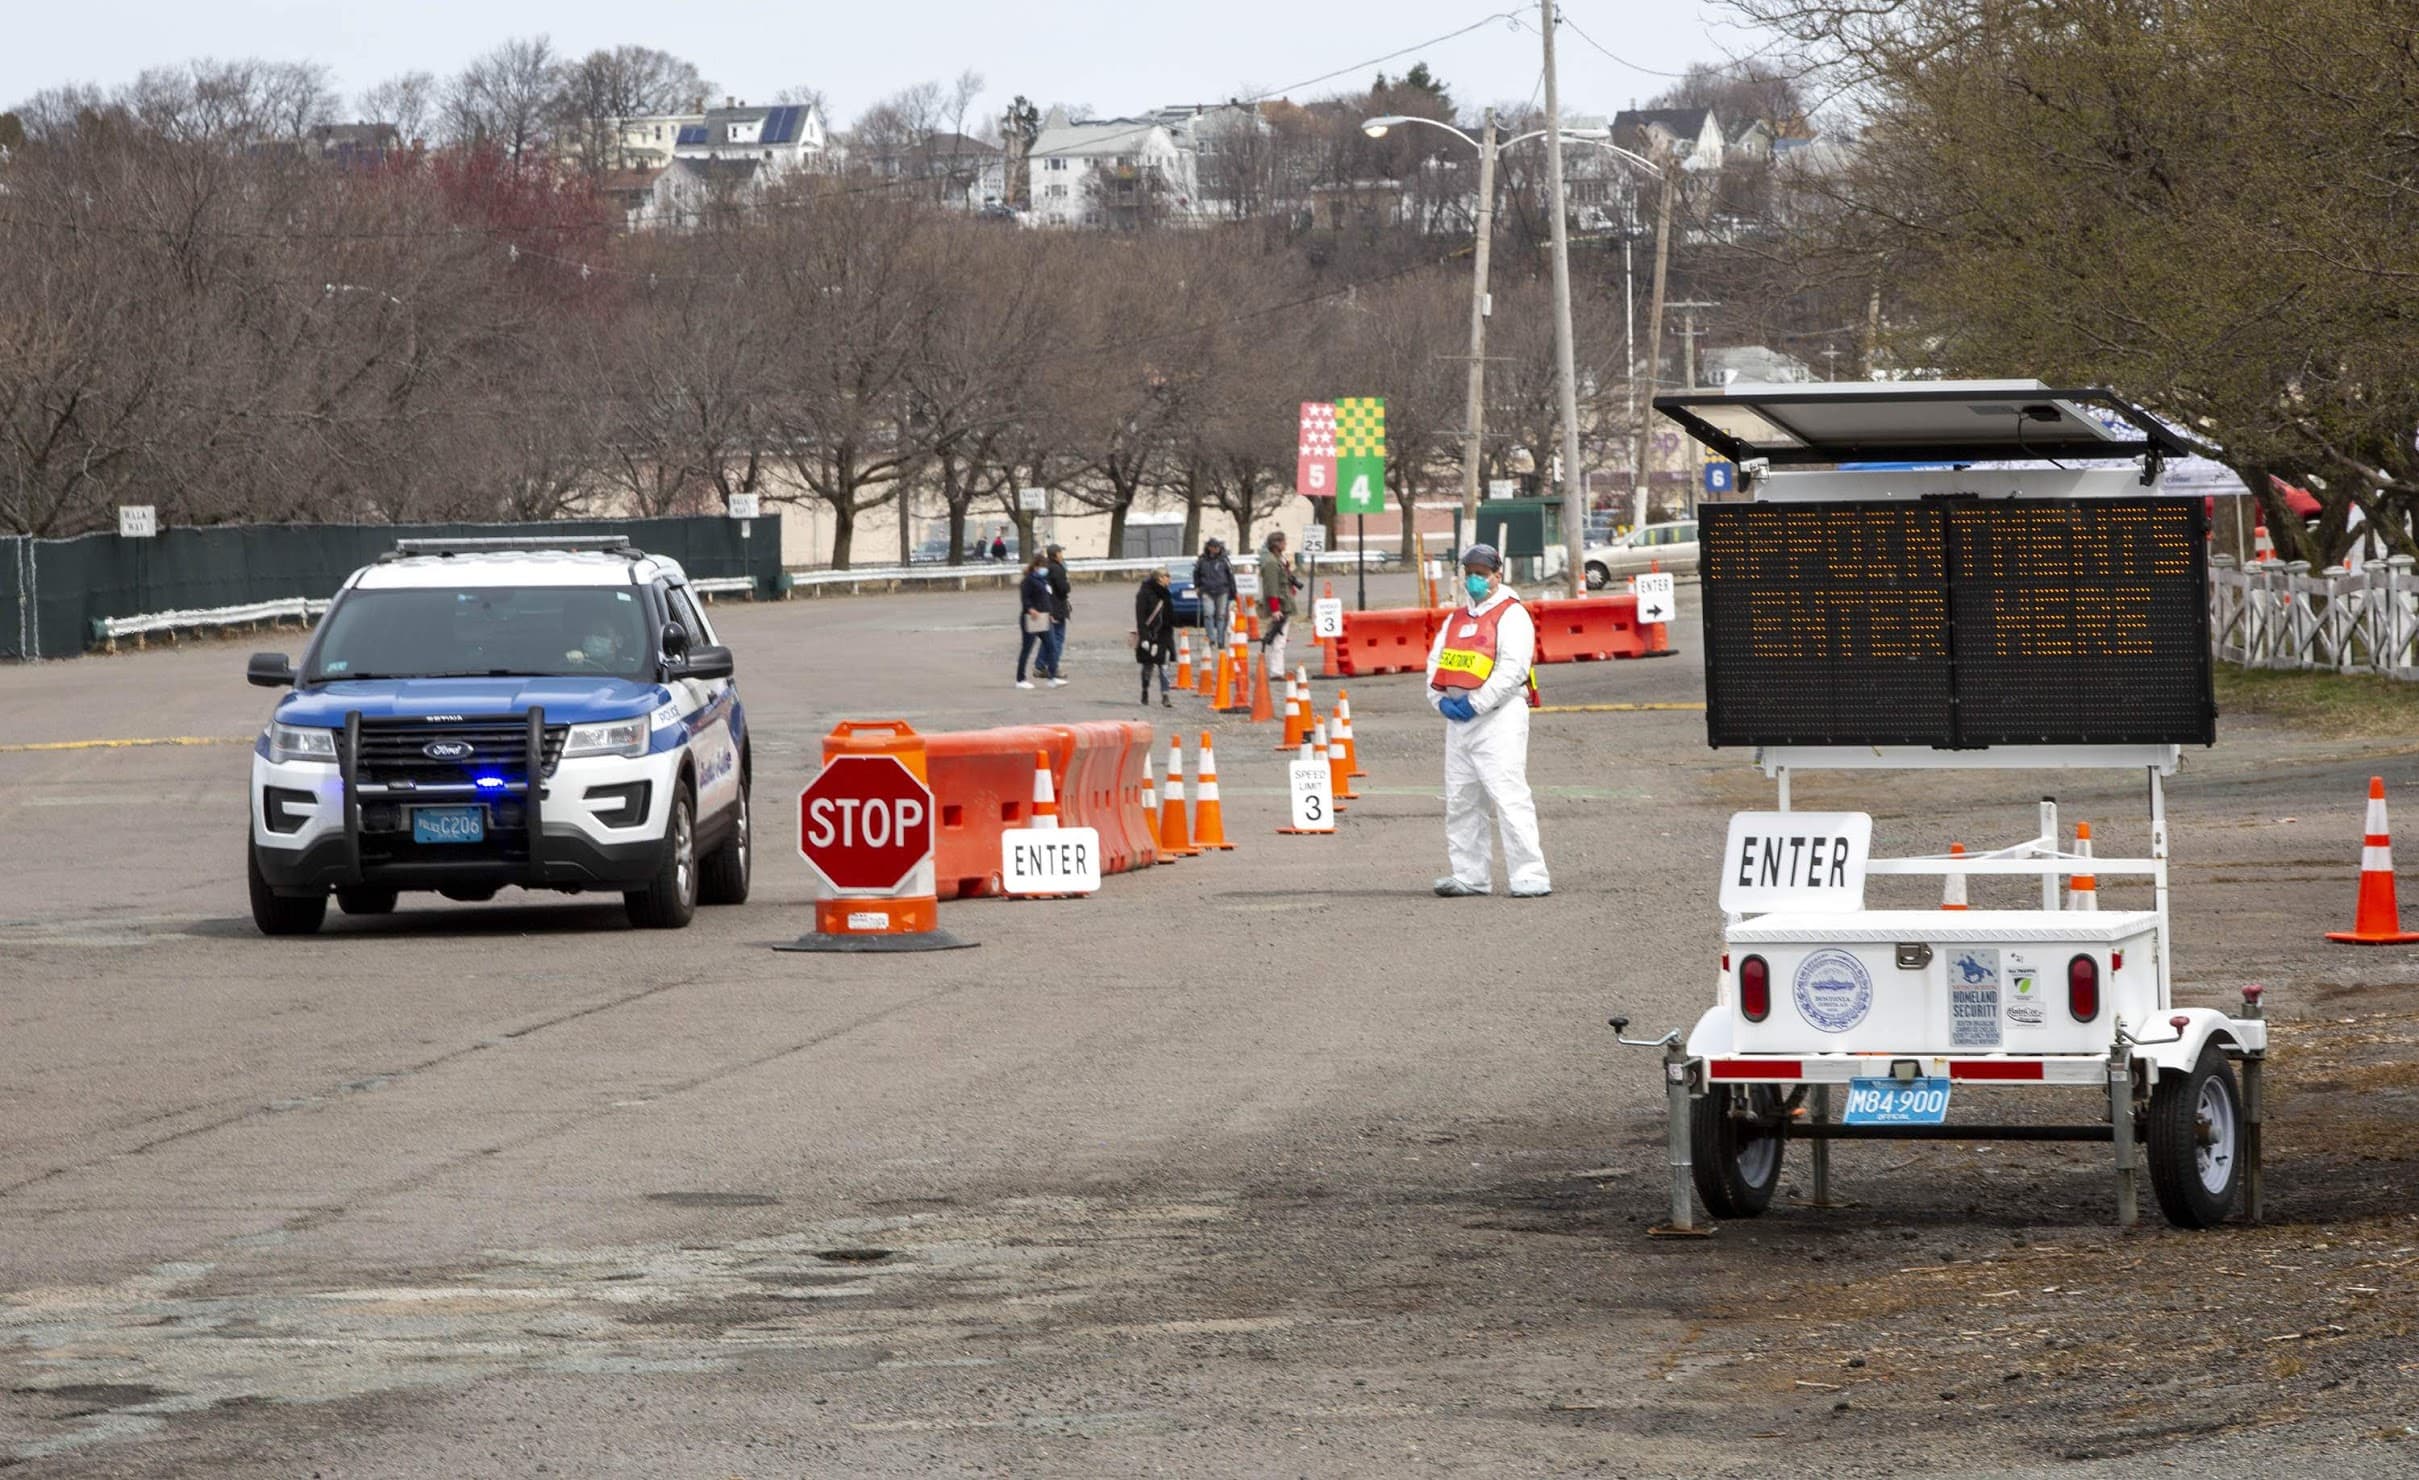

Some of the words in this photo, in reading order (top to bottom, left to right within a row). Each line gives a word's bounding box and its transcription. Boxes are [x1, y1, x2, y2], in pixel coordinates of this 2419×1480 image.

[1308, 464, 1326, 489] 5
[1712, 469, 1725, 487] 6
[1350, 474, 1371, 505] 4
[1304, 541, 1323, 552] 25
[1709, 507, 2191, 580] APPOINTMENTS
[1641, 579, 1669, 593] ENTER
[1324, 617, 1335, 632] 3
[1751, 590, 1946, 657] ENTER
[1994, 587, 2154, 656] HERE
[433, 744, 462, 756] Ford
[1295, 769, 1327, 780] SPEED
[1299, 782, 1323, 791] LIMIT
[1305, 795, 1322, 821] 3
[808, 797, 923, 848] STOP
[1015, 843, 1087, 876] ENTER
[1738, 836, 1849, 887] ENTER
[1953, 990, 1998, 1003] HOMELAND
[1953, 1004, 1998, 1018] SECURITY
